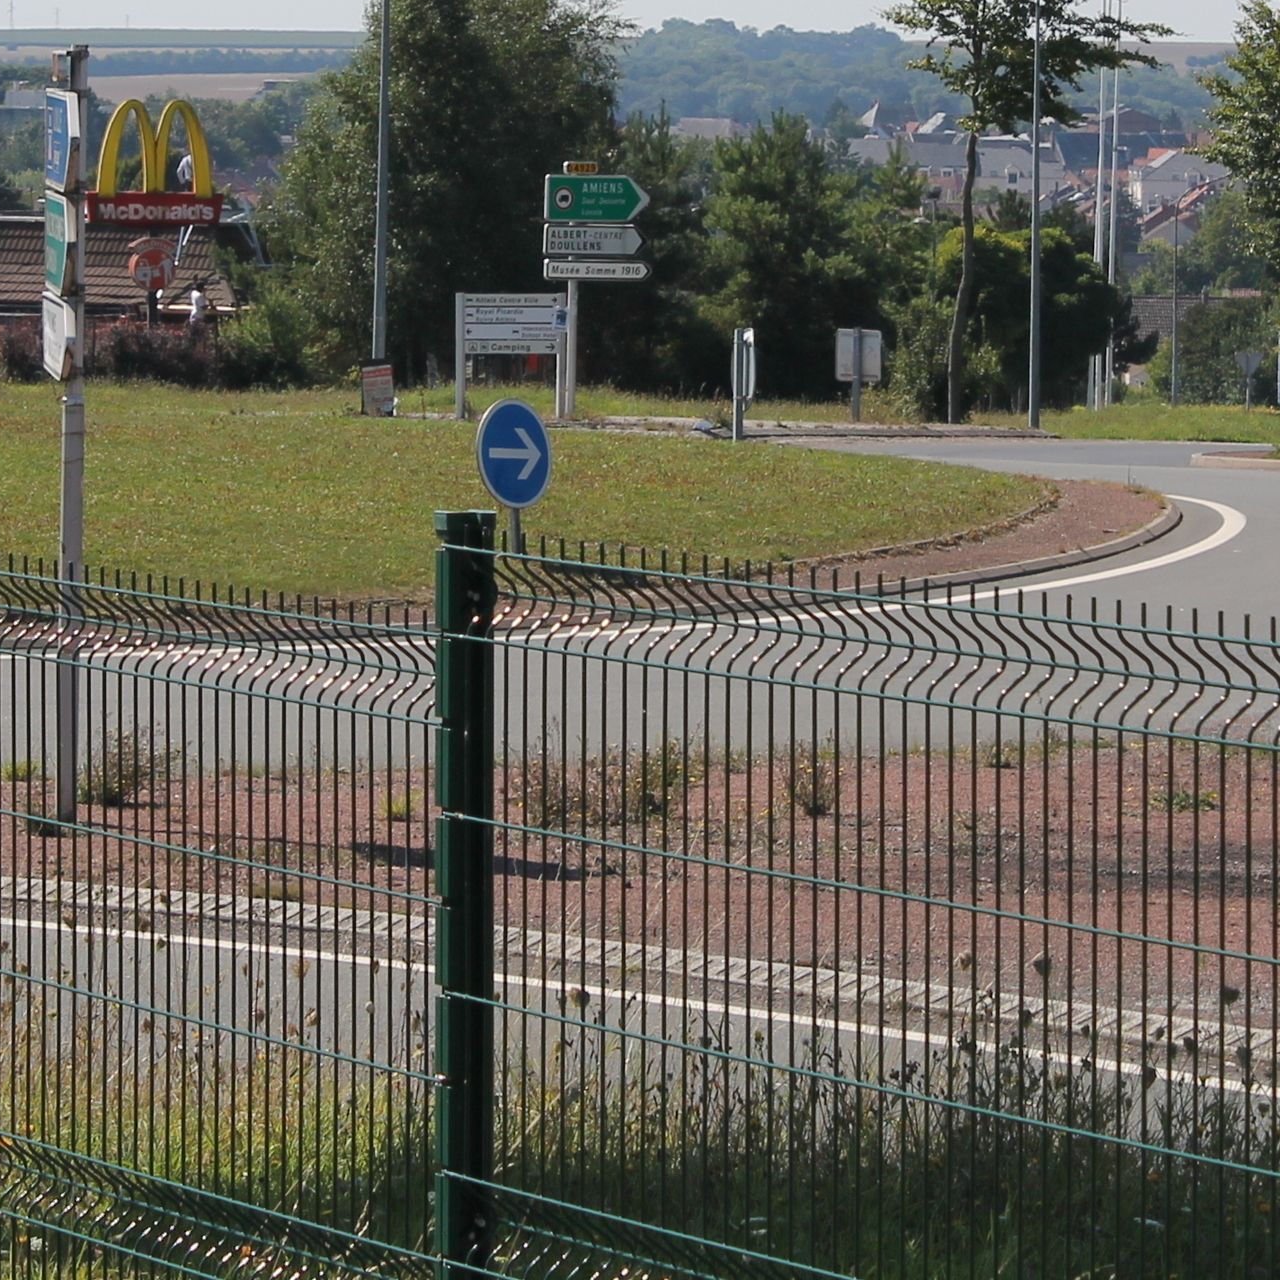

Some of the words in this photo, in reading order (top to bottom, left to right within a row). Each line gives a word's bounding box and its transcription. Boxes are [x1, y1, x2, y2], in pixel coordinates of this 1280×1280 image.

[582, 183, 624, 193] AMIENS
[98, 203, 214, 220] McDonald's
[550, 241, 601, 251] DOULLENS
[552, 266, 580, 275] Musée
[585, 266, 616, 275] Somme
[621, 266, 641, 276] 1916
[491, 343, 531, 354] Camping
